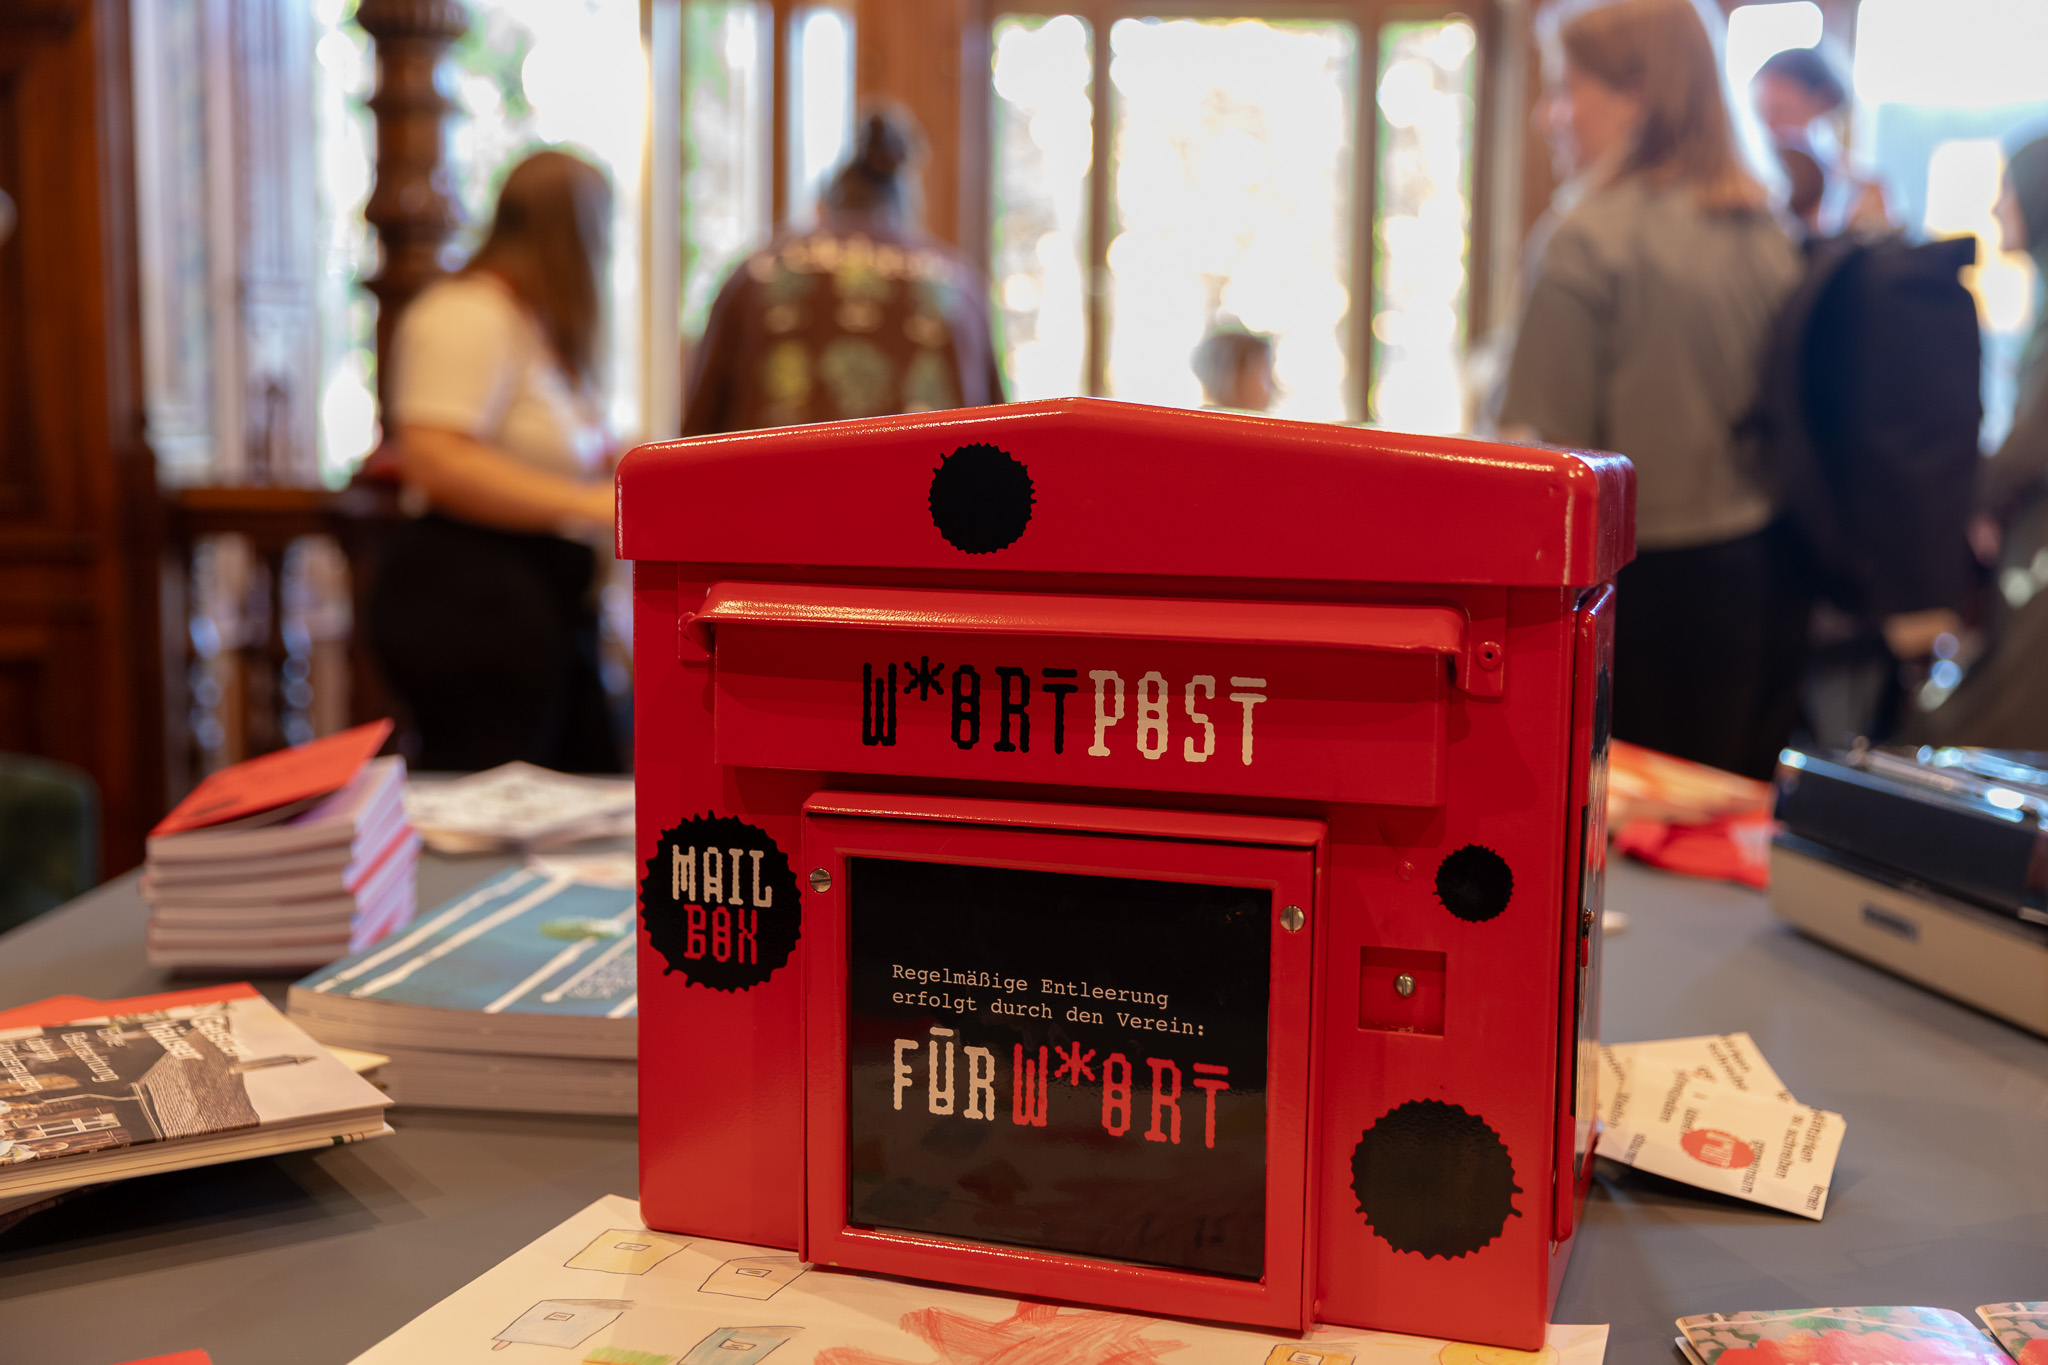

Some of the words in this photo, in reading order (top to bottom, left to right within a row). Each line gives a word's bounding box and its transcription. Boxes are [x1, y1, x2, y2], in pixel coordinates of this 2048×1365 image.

[672, 844, 773, 908] MAIL
[683, 903, 758, 965] BOX
[892, 964, 1028, 993] Regelmäßige
[1040, 979, 1169, 1009] Entleerung
[892, 990, 978, 1014] erfolgt
[990, 998, 1053, 1019] durch
[1065, 1006, 1104, 1025] den
[1116, 1012, 1205, 1036] Verein:
